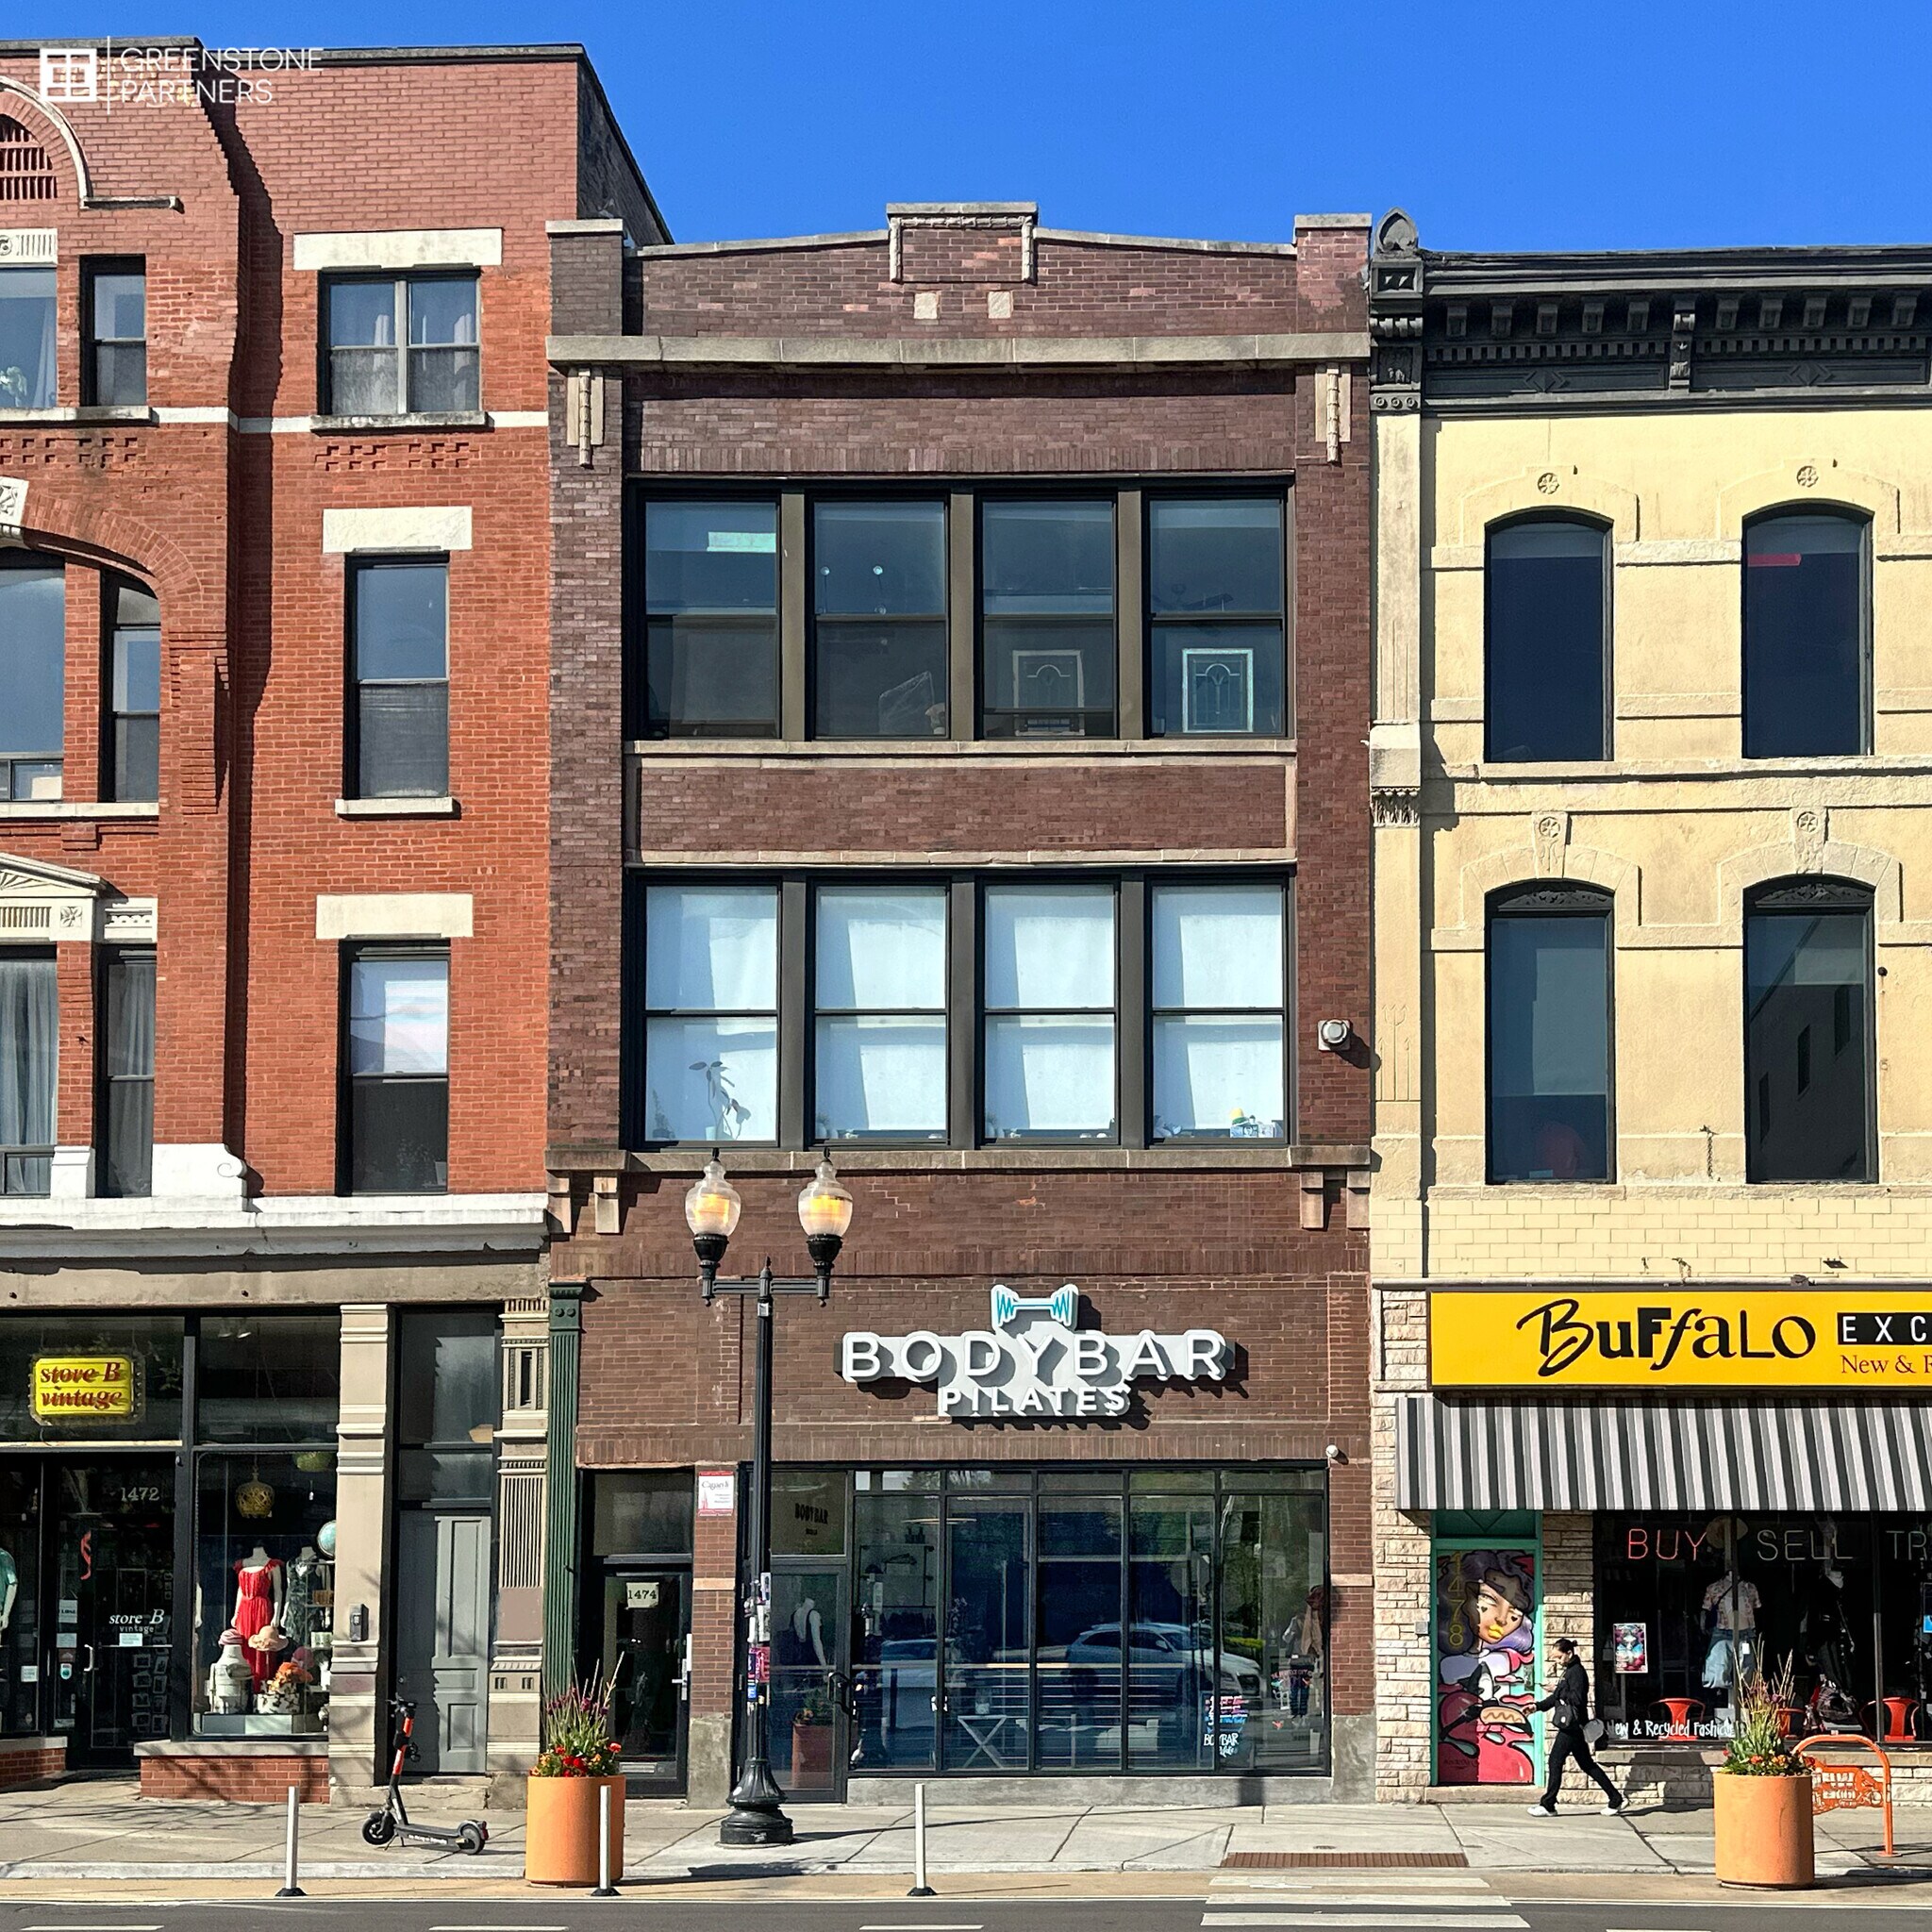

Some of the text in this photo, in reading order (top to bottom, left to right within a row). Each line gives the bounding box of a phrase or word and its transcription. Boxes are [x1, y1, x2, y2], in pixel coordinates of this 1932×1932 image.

[1842, 1315, 1927, 1342] EXC
[841, 1330, 1228, 1382] BODYBAR
[1840, 1355, 1890, 1374] New
[1894, 1356, 1915, 1374] &
[41, 1362, 121, 1384] store B
[42, 1386, 123, 1410] vintage
[941, 1387, 1132, 1414] PILATES
[120, 1487, 160, 1502] 1472
[1627, 1528, 1707, 1561] BUY
[1757, 1529, 1854, 1561] SELL
[628, 1590, 658, 1600] 1474
[108, 1608, 165, 1624] store B
[119, 1624, 154, 1635] vintage
[1633, 1719, 1641, 1736] &
[1645, 1719, 1690, 1738] Recycled
